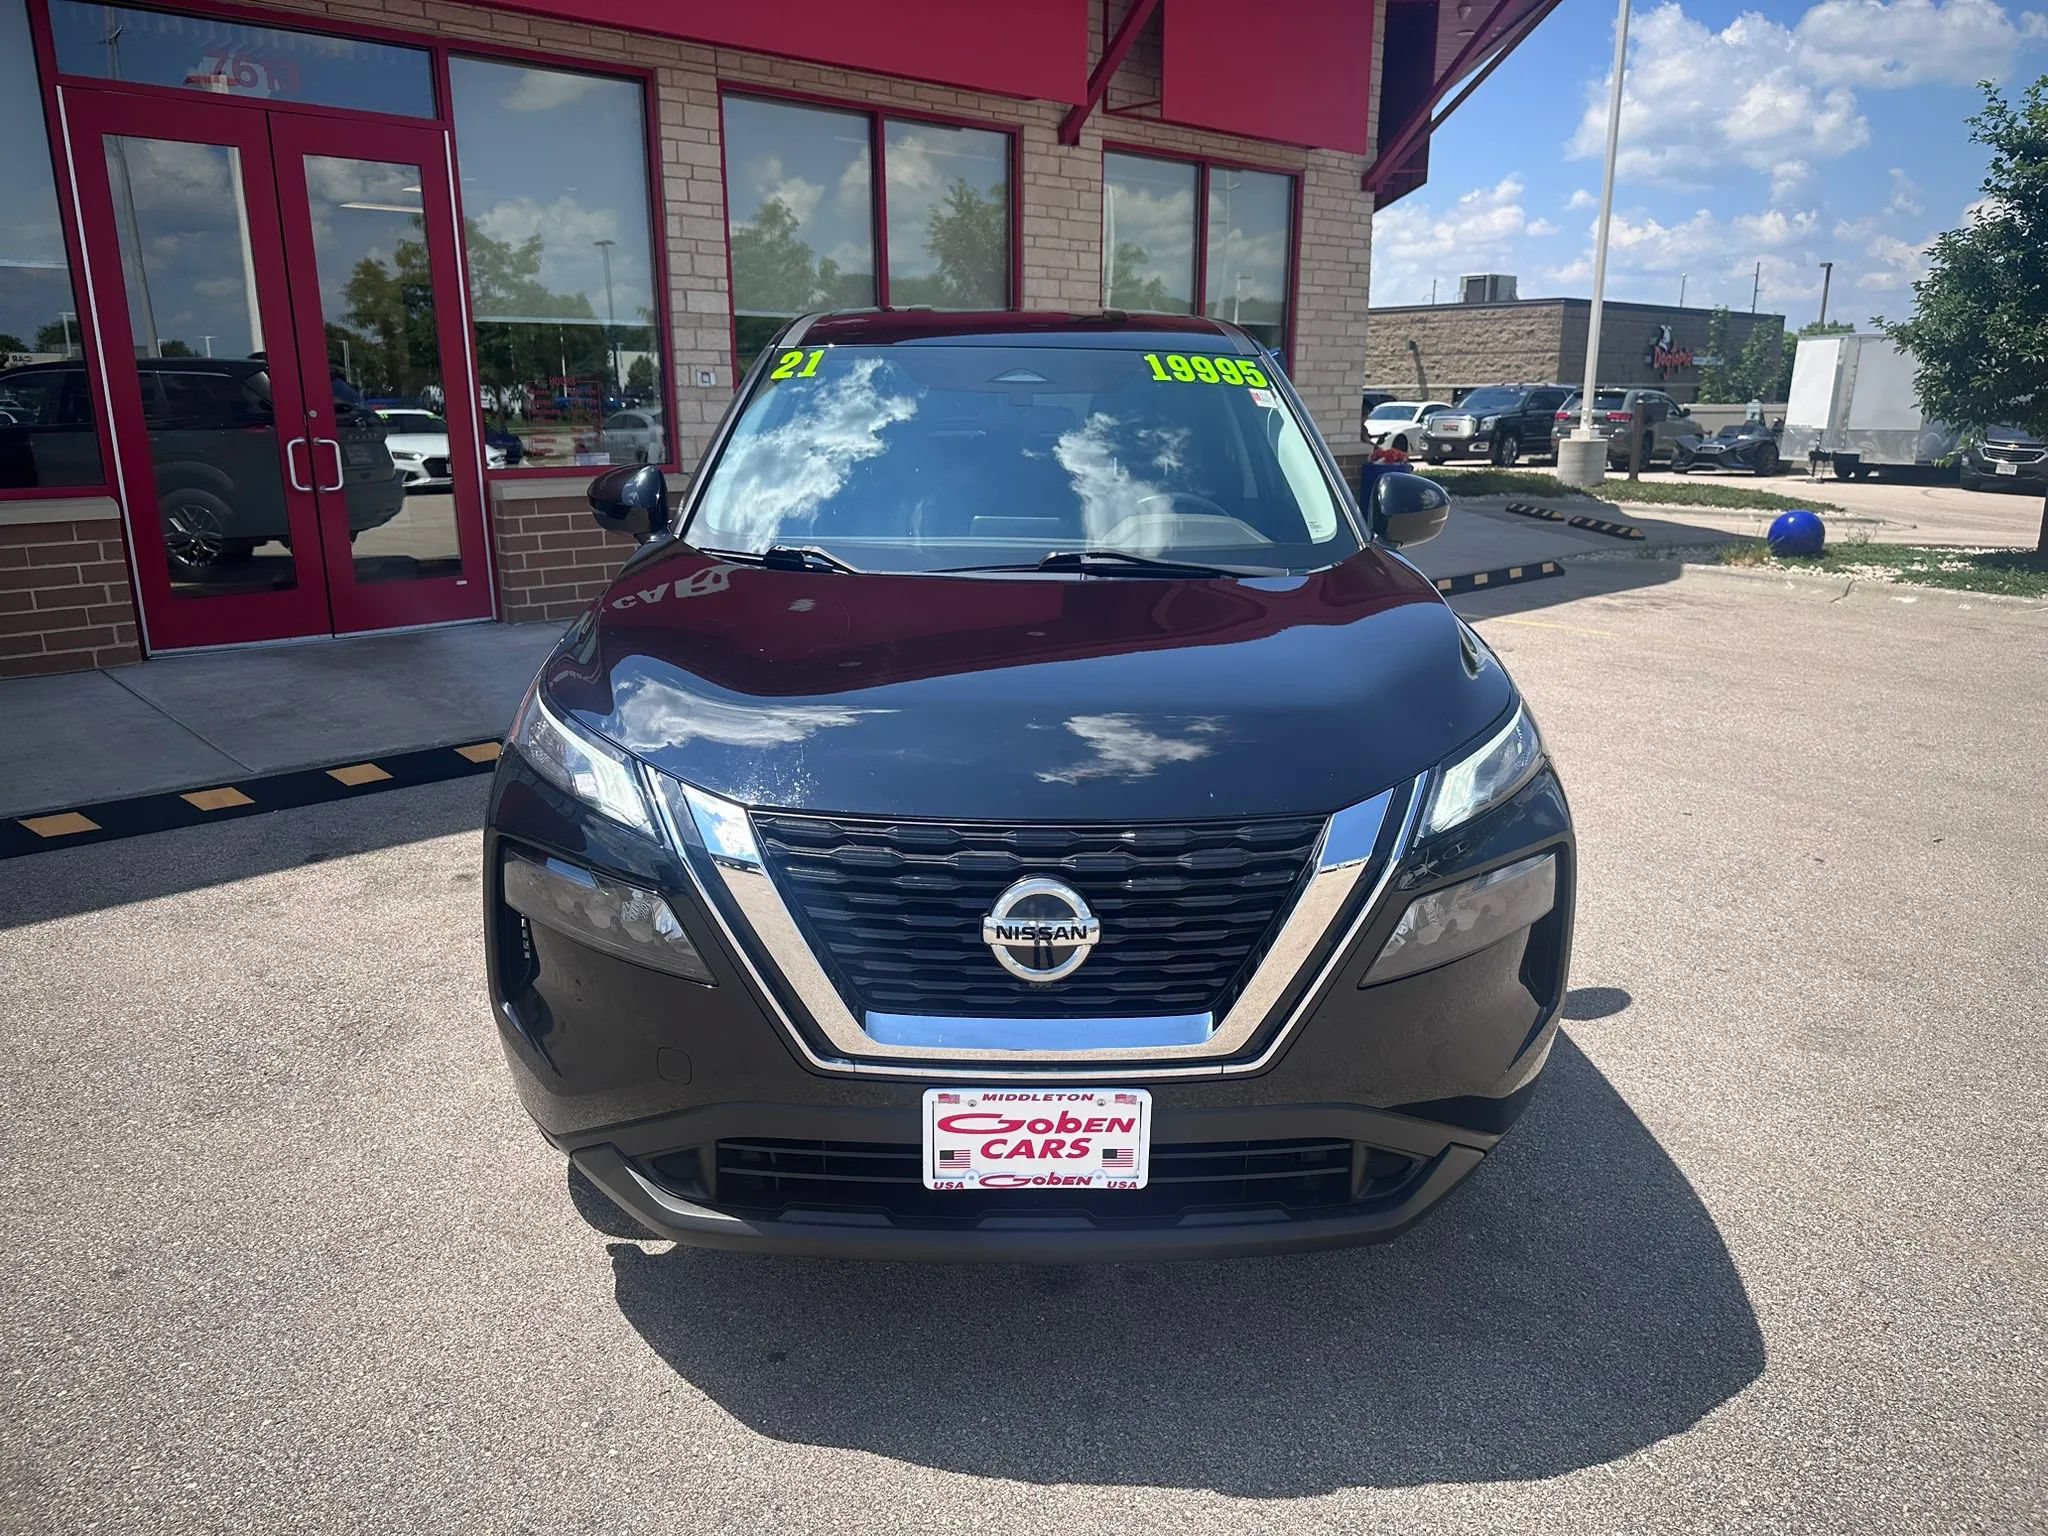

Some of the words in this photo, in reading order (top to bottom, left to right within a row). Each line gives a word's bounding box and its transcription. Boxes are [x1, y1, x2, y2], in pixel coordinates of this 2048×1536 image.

[770, 350, 825, 380] 21
[1143, 353, 1268, 388] 19995
[996, 925, 1088, 940] NISSAN
[982, 1093, 1095, 1101] MIDDLETON
[980, 1137, 1092, 1159] CARS
[933, 1181, 965, 1190] USA
[1106, 1181, 1138, 1190] USA
